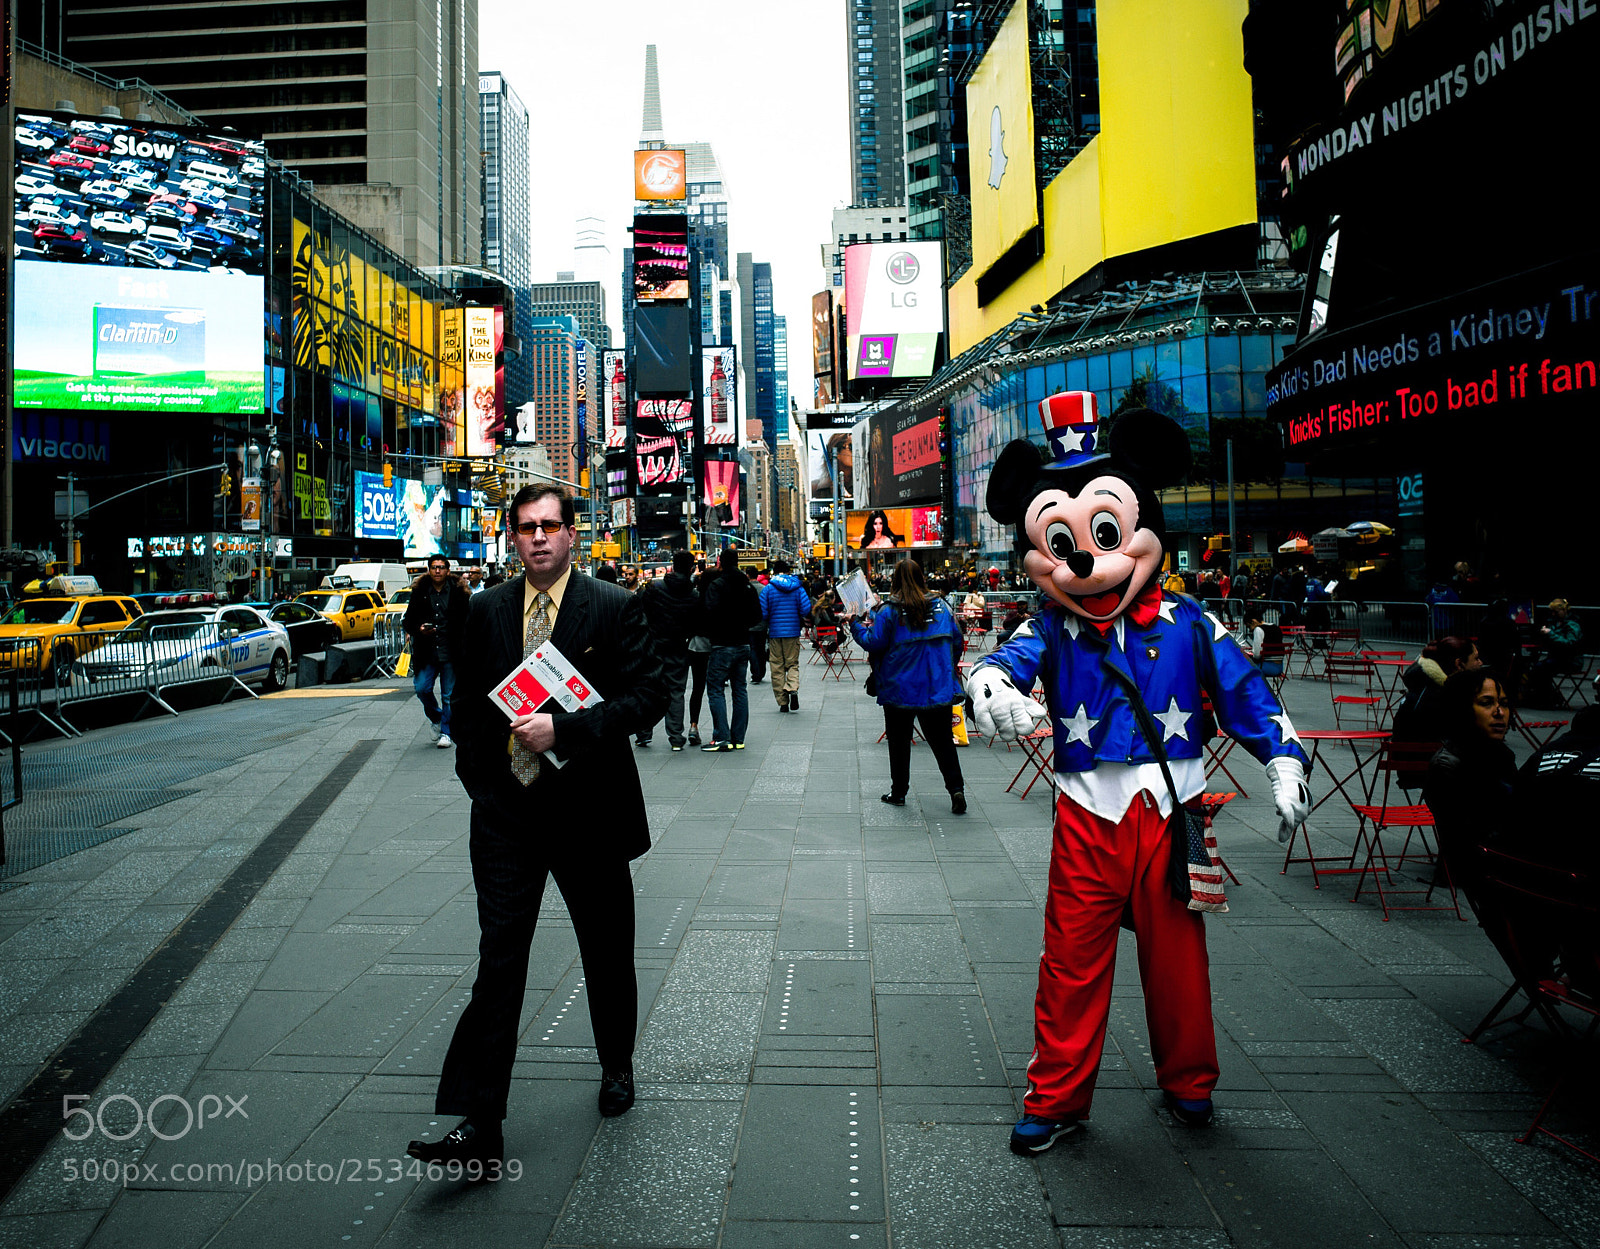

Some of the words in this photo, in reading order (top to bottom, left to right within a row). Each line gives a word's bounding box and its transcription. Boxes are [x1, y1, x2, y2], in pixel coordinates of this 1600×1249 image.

[1298, 113, 1375, 179] MONDAY
[1383, 64, 1468, 136] NIGHTS
[1474, 36, 1506, 85] ON
[113, 134, 175, 160] Slow
[118, 276, 169, 299] Fast
[891, 292, 918, 308] LG
[470, 336, 490, 348] LION
[1281, 366, 1310, 399] Kid's
[1313, 351, 1346, 388] Dad
[1353, 334, 1419, 376] Needs
[1428, 331, 1442, 356] a
[1450, 303, 1550, 350] Kidney
[469, 349, 493, 363] KING
[576, 346, 587, 400] NOVOTEL
[66, 382, 86, 394] Get
[87, 384, 106, 393] fast
[109, 384, 134, 394] nasal
[136, 386, 191, 397] congestion
[192, 387, 218, 397] relief
[81, 393, 92, 402] at
[94, 393, 111, 403] the
[113, 394, 161, 405] pharmacy
[163, 396, 204, 405] counter.
[1289, 408, 1324, 446] Knicks'
[1328, 399, 1390, 434] Fisher:
[1396, 387, 1438, 419] Too
[1447, 369, 1498, 410] bad
[1508, 363, 1529, 400] if
[1537, 358, 1600, 394] fan
[296, 475, 326, 499] FINDNG
[384, 513, 395, 521] OFF
[541, 658, 564, 682] pixability
[509, 681, 528, 702] Beauty
[526, 699, 535, 708] on
